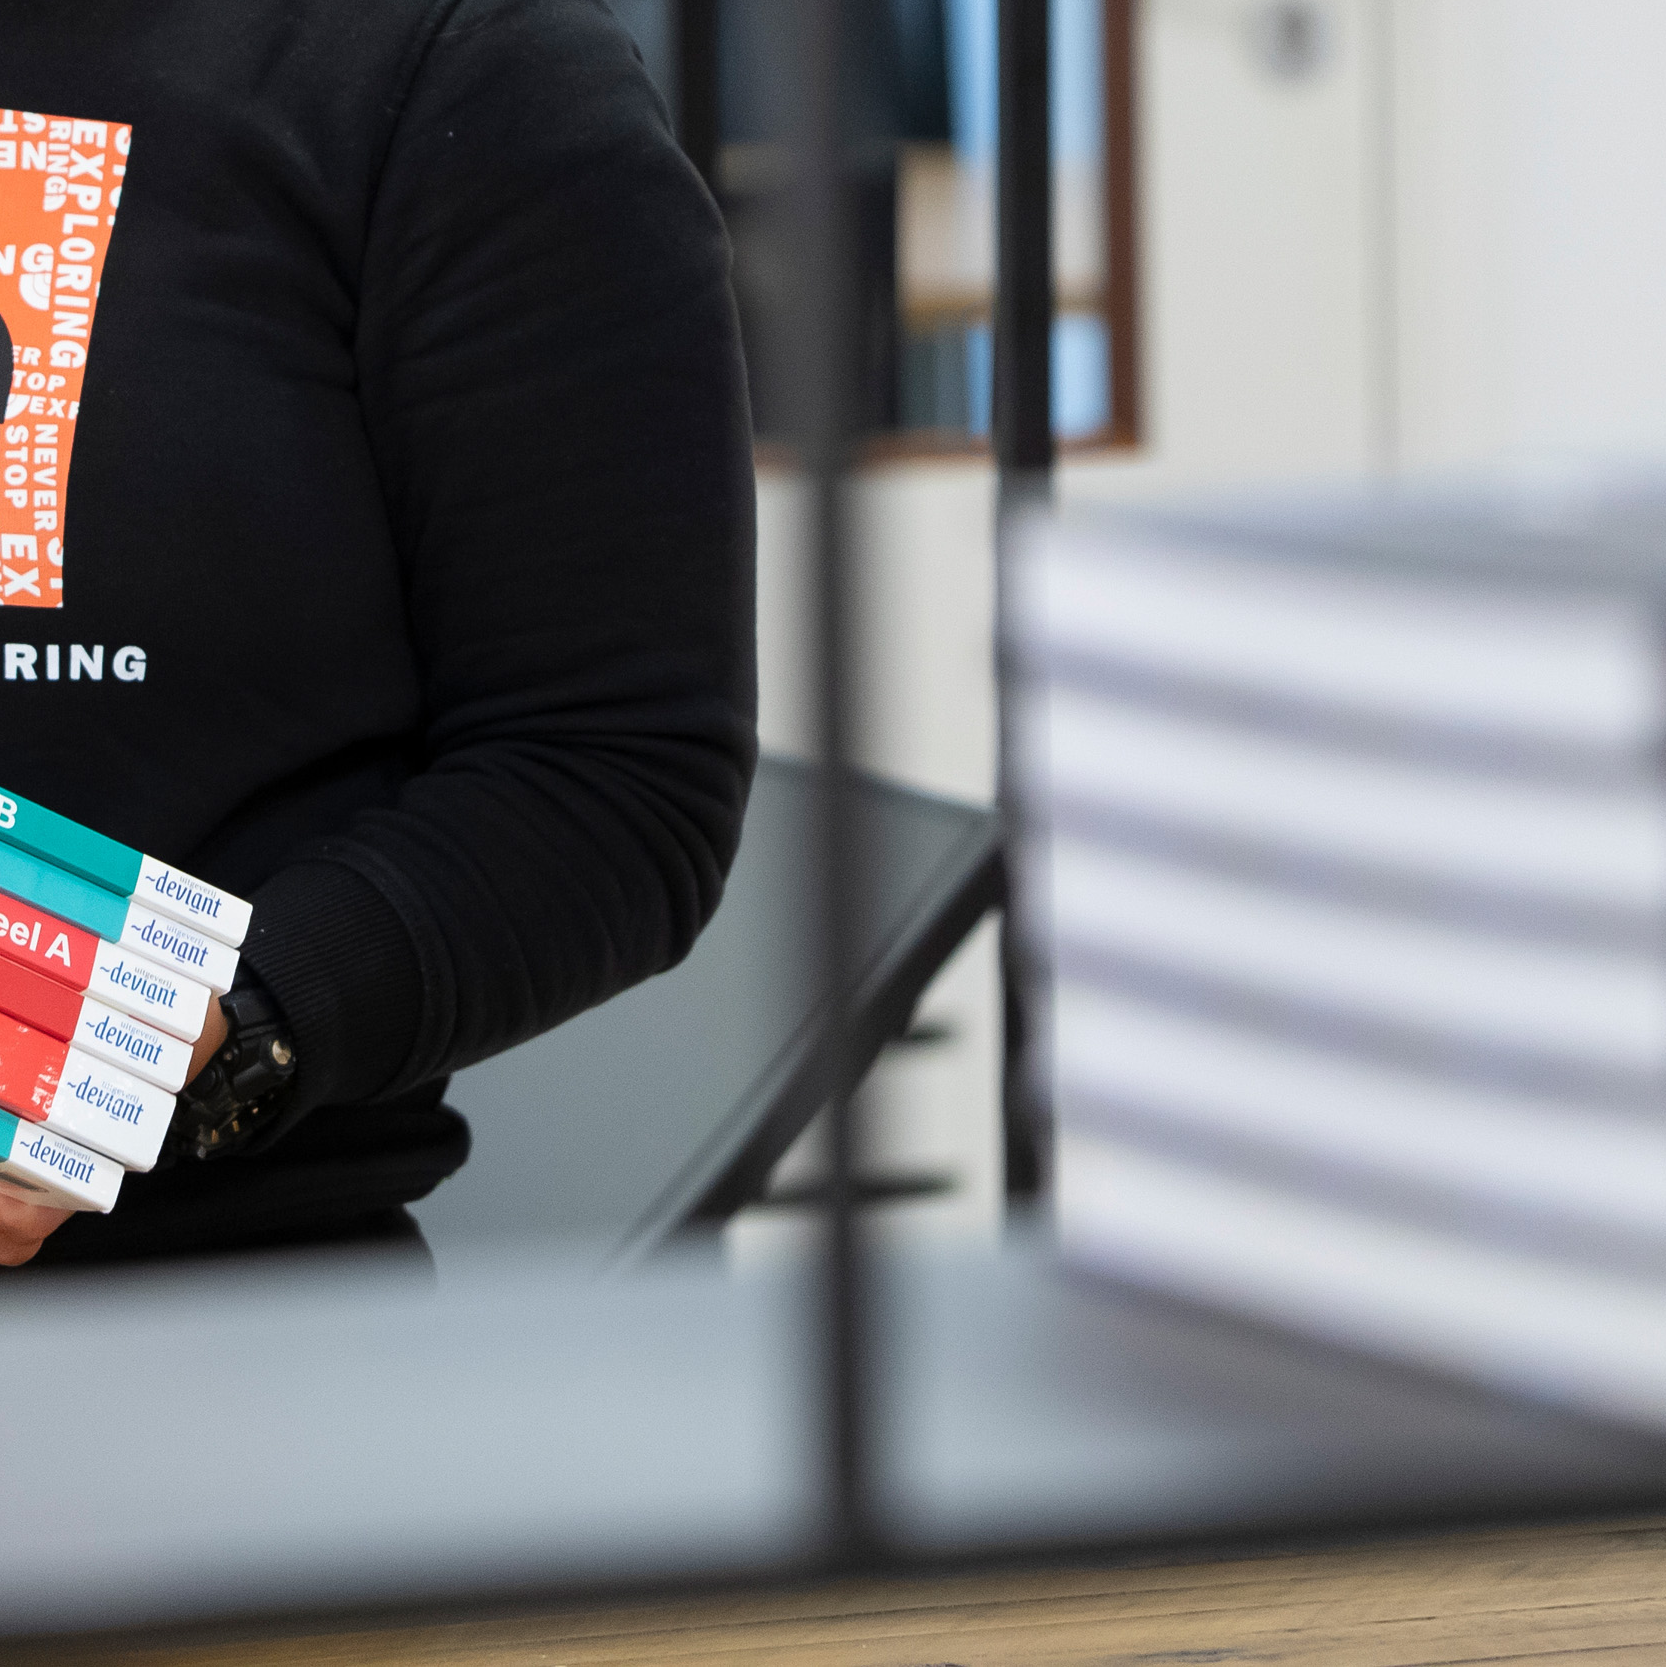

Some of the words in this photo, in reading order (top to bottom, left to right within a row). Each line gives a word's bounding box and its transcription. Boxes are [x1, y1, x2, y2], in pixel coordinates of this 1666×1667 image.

[50, 119, 108, 369] EXPLORING
[4, 424, 30, 509] STOP
[33, 423, 59, 532] NEVER
[179, 875, 218, 899] uitgeverij
[165, 924, 205, 948] uitgeverij
[44, 932, 73, 968] A
[133, 965, 173, 990] uitgeverij
[119, 1020, 160, 1045] uitgeverij
[54, 1139, 92, 1163] uitgeverij
